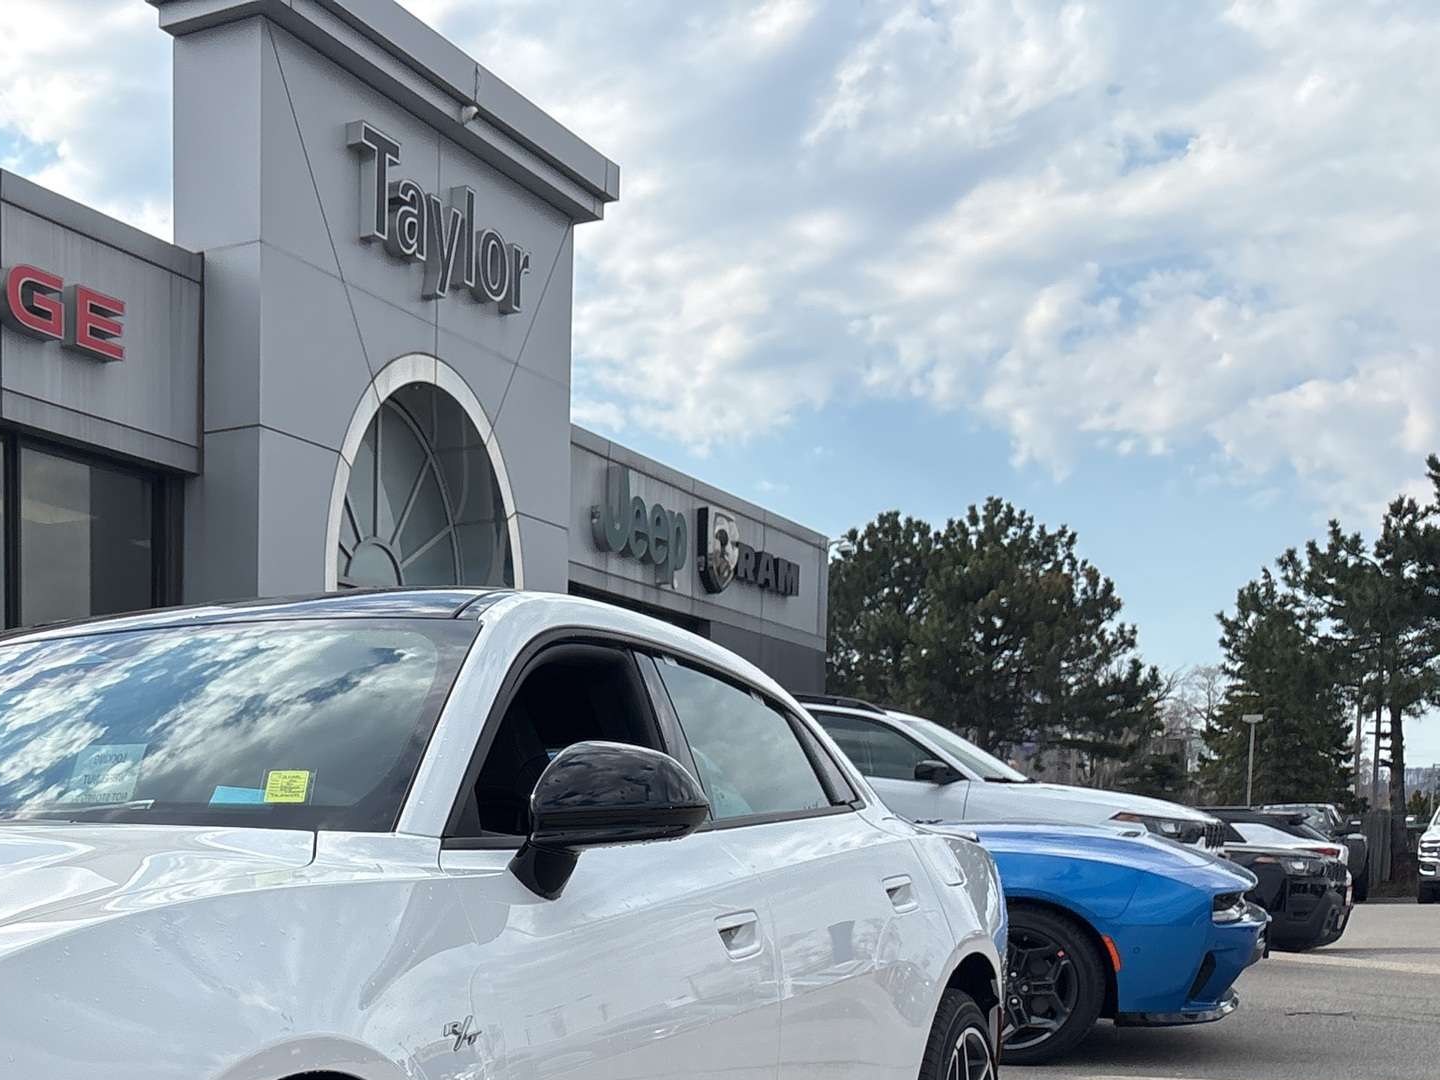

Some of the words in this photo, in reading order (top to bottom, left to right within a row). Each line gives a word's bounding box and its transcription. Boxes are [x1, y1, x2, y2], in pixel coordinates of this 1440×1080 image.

[347, 120, 532, 314] Taylor
[592, 464, 688, 590] Jeep
[736, 542, 800, 597] RAM
